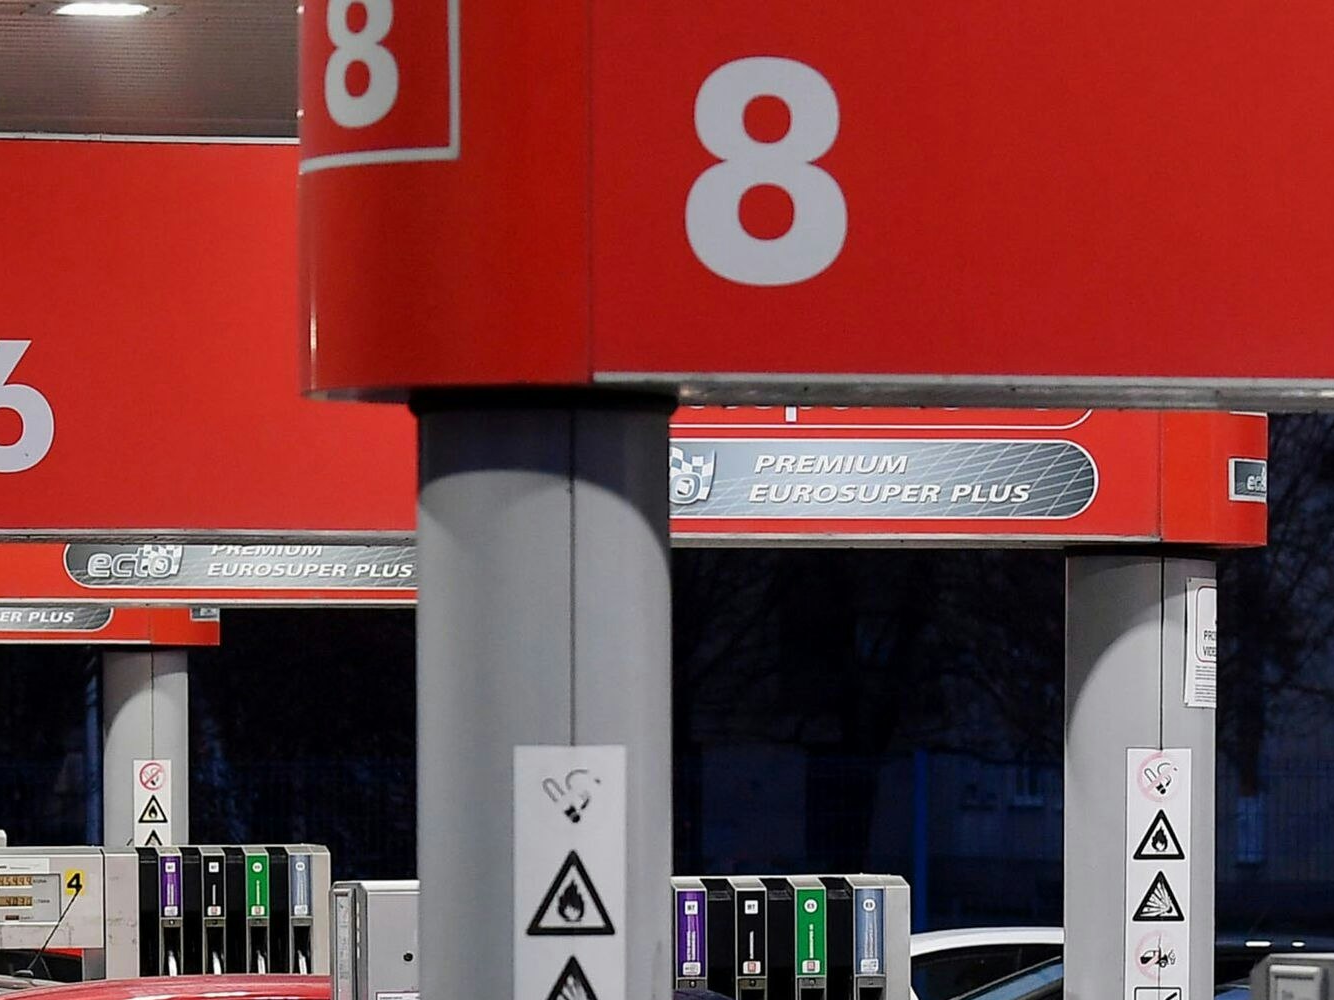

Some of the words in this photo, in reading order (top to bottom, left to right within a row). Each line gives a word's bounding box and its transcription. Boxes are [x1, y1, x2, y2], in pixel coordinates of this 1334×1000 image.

[324, 0, 399, 128] 8
[684, 56, 848, 286] 8
[753, 455, 909, 475] PREMIUM
[748, 483, 941, 504] EUROSUPER
[950, 484, 1032, 504] PLUS
[210, 545, 324, 557] PREMIUM
[87, 546, 173, 578] ecto
[207, 562, 347, 578] EUROSUPER
[354, 564, 413, 578] PLUS
[28, 611, 75, 624] PLUS
[66, 873, 83, 892] 4
